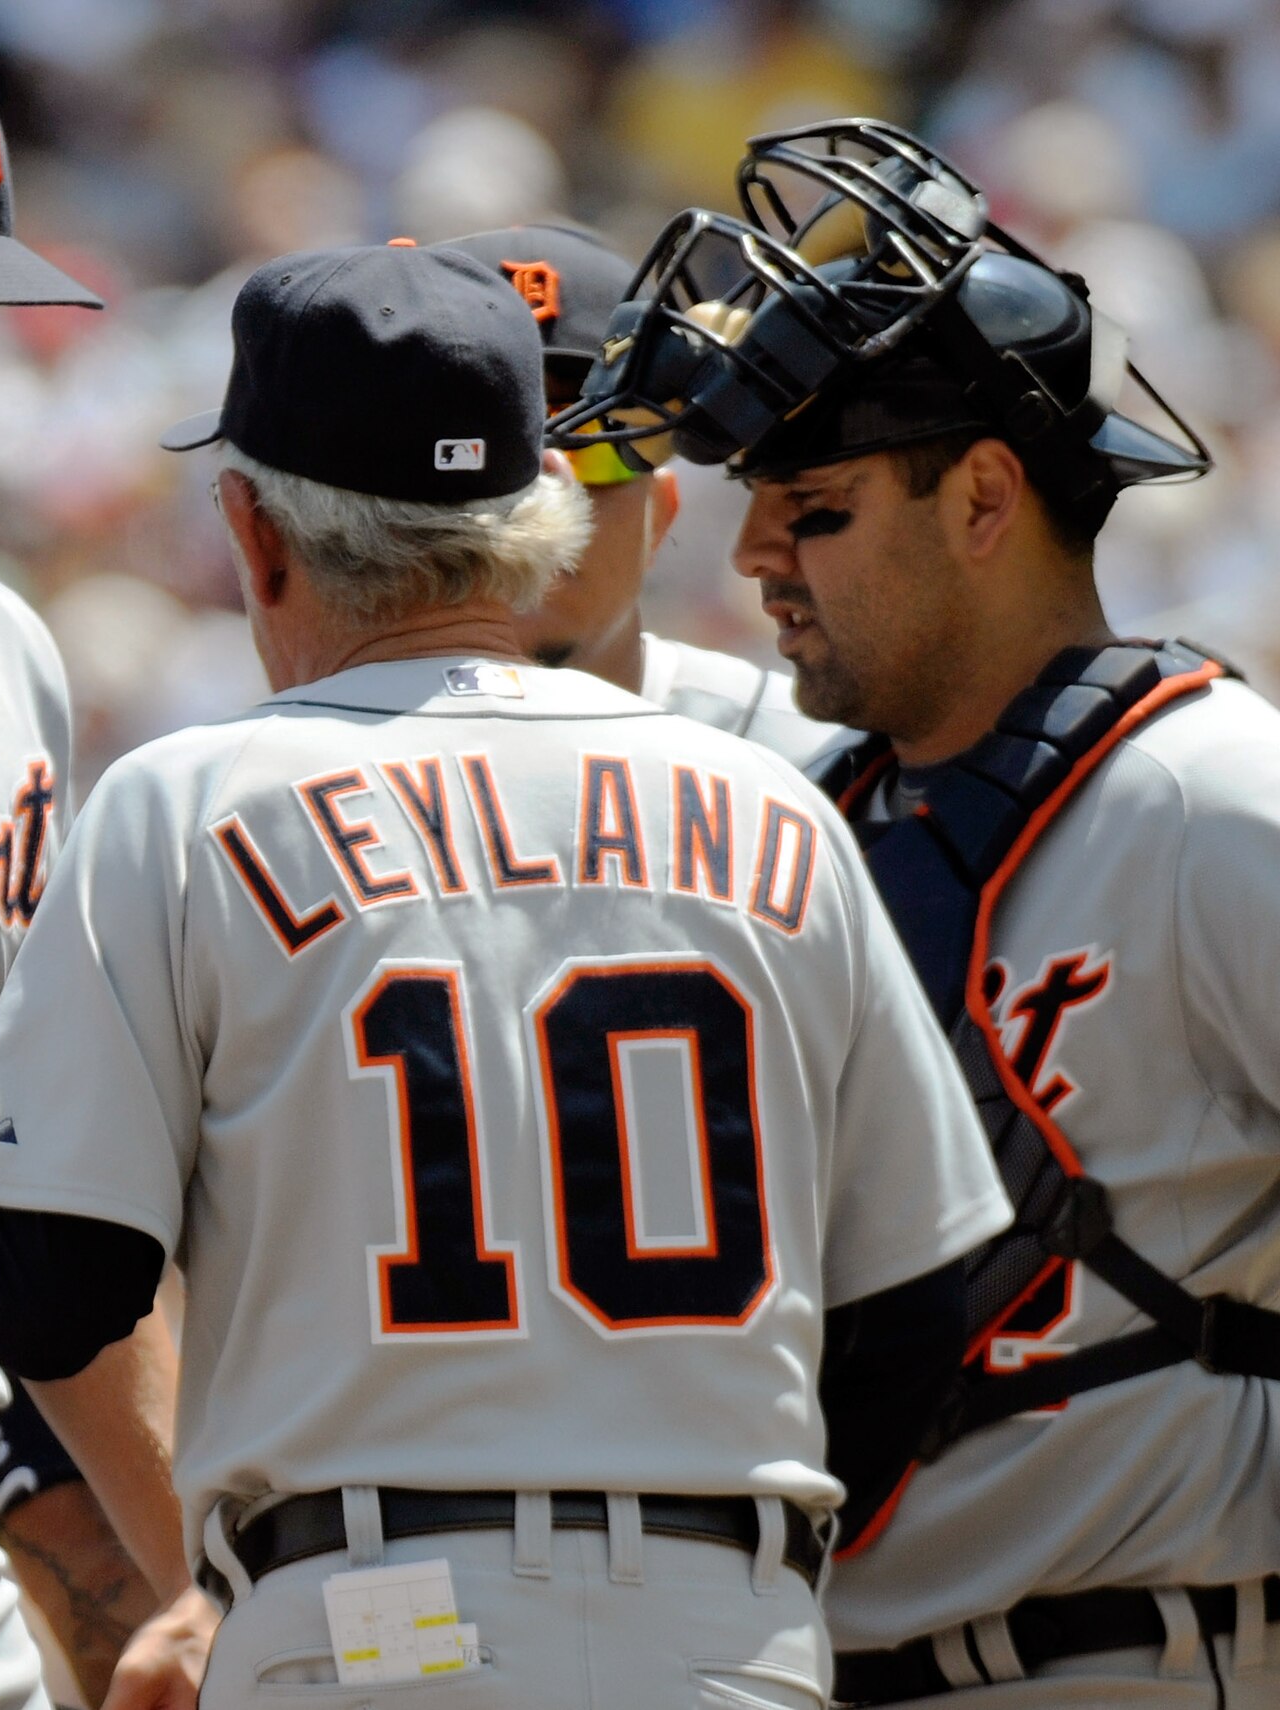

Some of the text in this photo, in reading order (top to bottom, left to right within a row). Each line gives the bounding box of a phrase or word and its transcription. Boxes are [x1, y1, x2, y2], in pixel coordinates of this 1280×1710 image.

[500, 258, 560, 322] D
[209, 753, 817, 958] LEYLAND
[343, 954, 778, 1344] 10
